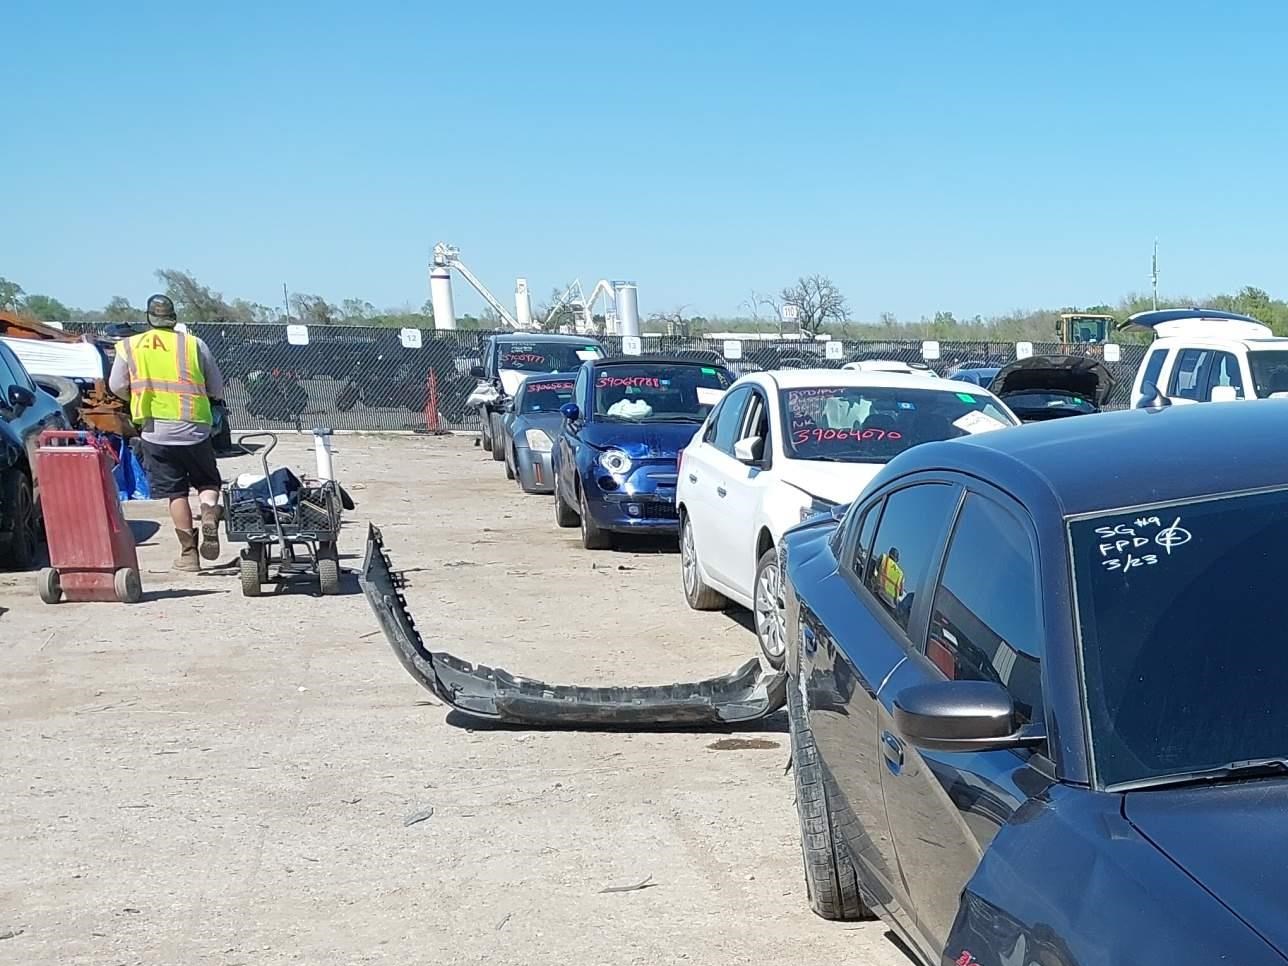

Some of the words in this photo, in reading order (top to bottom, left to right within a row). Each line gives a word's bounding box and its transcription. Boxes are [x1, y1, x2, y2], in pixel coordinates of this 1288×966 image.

[406, 334, 418, 343] 12
[793, 427, 903, 445] 39064070
[1095, 523, 1136, 539] SG
[1099, 537, 1149, 556] FPD
[1101, 553, 1159, 573] 3/23
